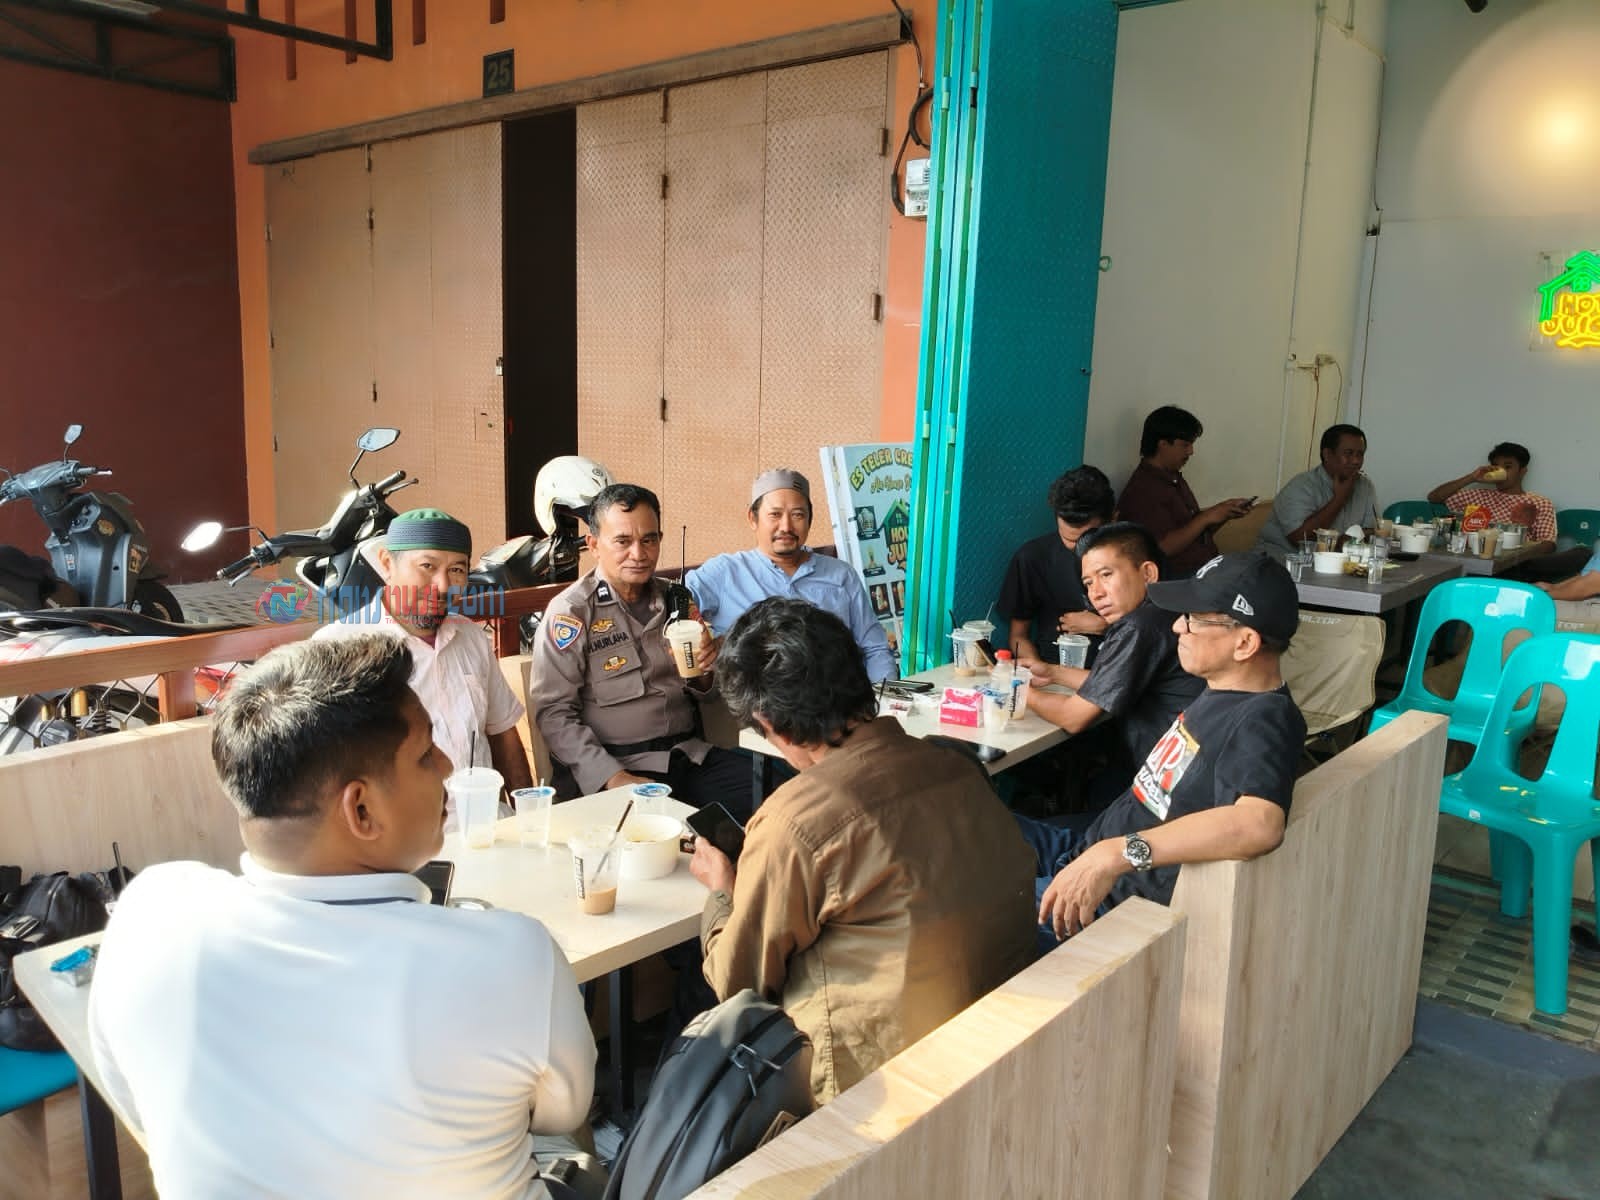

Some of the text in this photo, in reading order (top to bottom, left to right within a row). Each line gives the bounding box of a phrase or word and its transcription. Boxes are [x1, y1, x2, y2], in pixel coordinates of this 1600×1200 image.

[487, 58, 511, 89] 25
[1558, 293, 1600, 316] HO
[850, 466, 864, 491] ES
[861, 448, 893, 475] TELER
